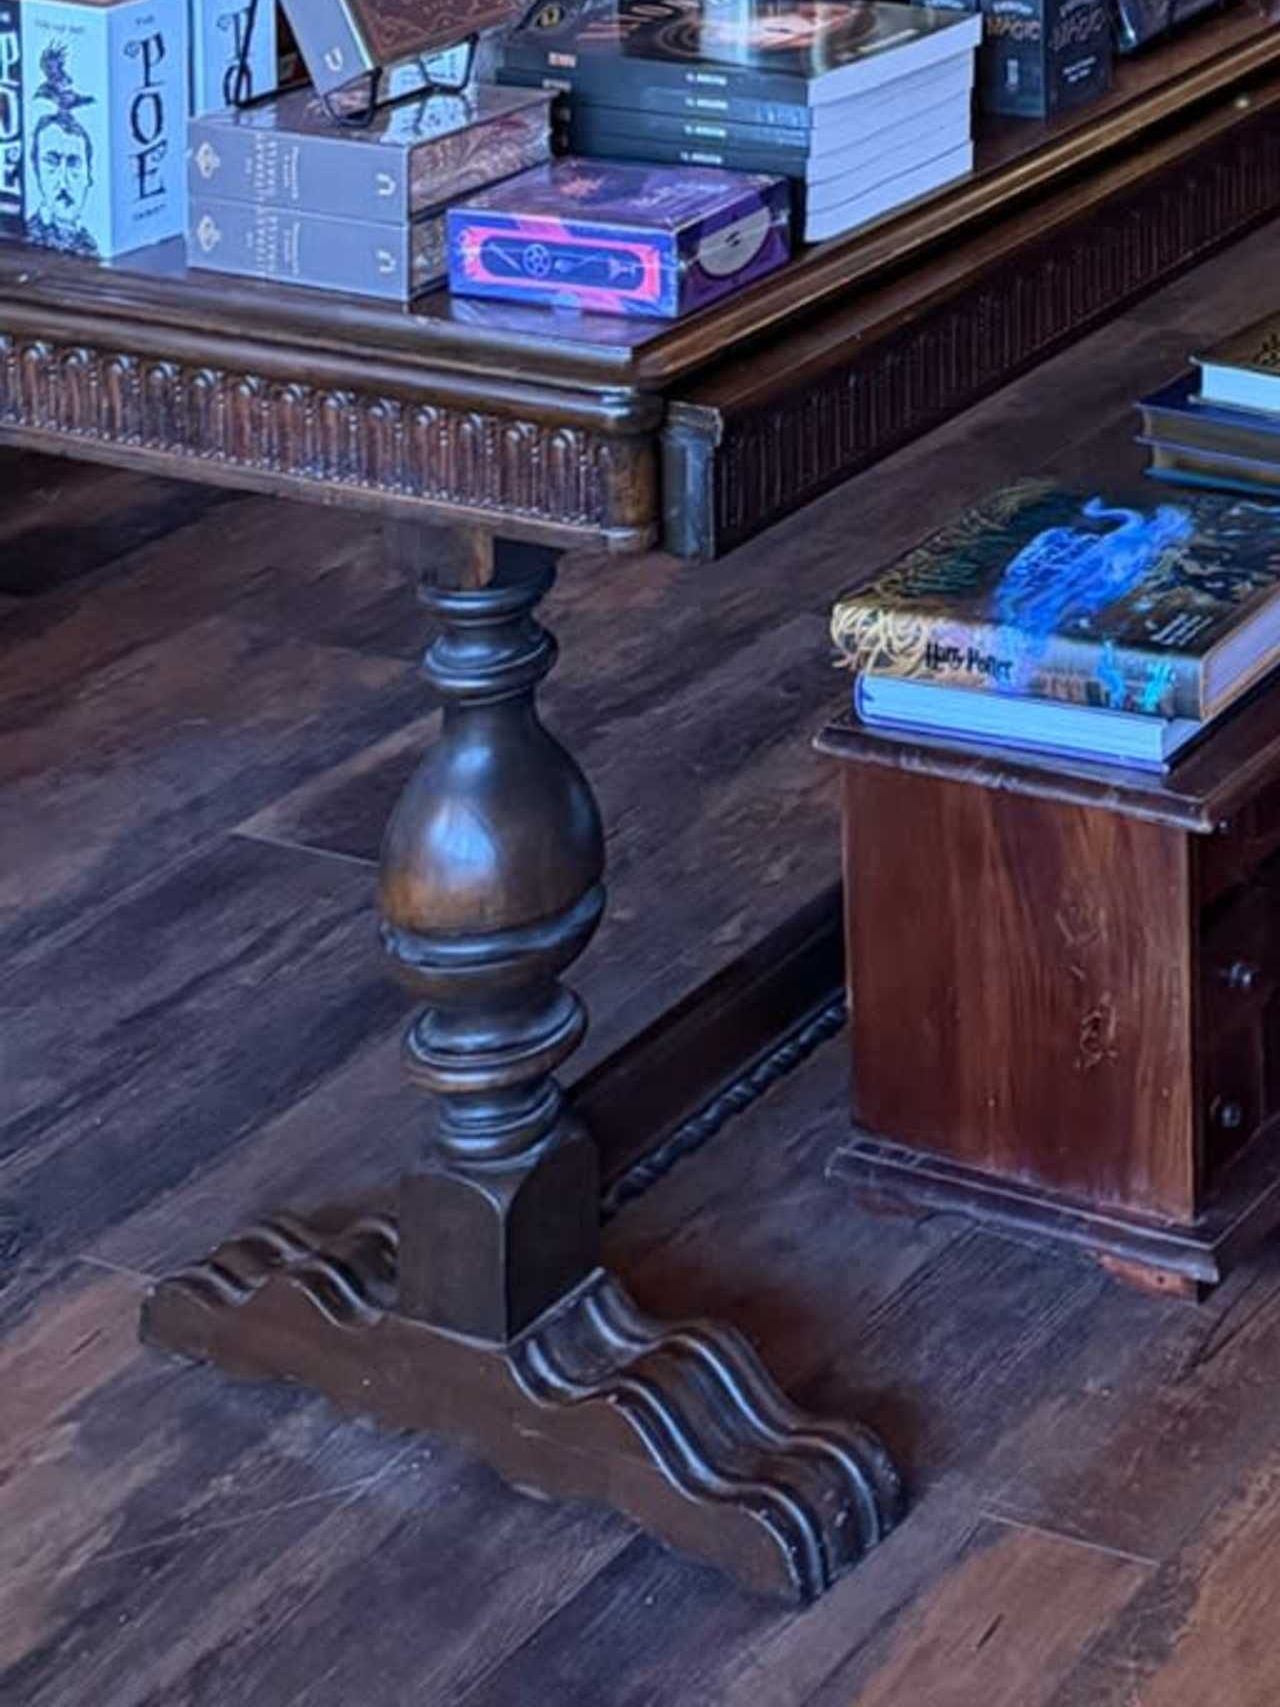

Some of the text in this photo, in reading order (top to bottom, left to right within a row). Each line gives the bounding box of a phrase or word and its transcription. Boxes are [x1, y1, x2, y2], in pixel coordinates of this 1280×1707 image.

[123, 31, 168, 202] POE
[922, 641, 1015, 683] Harry Potter
